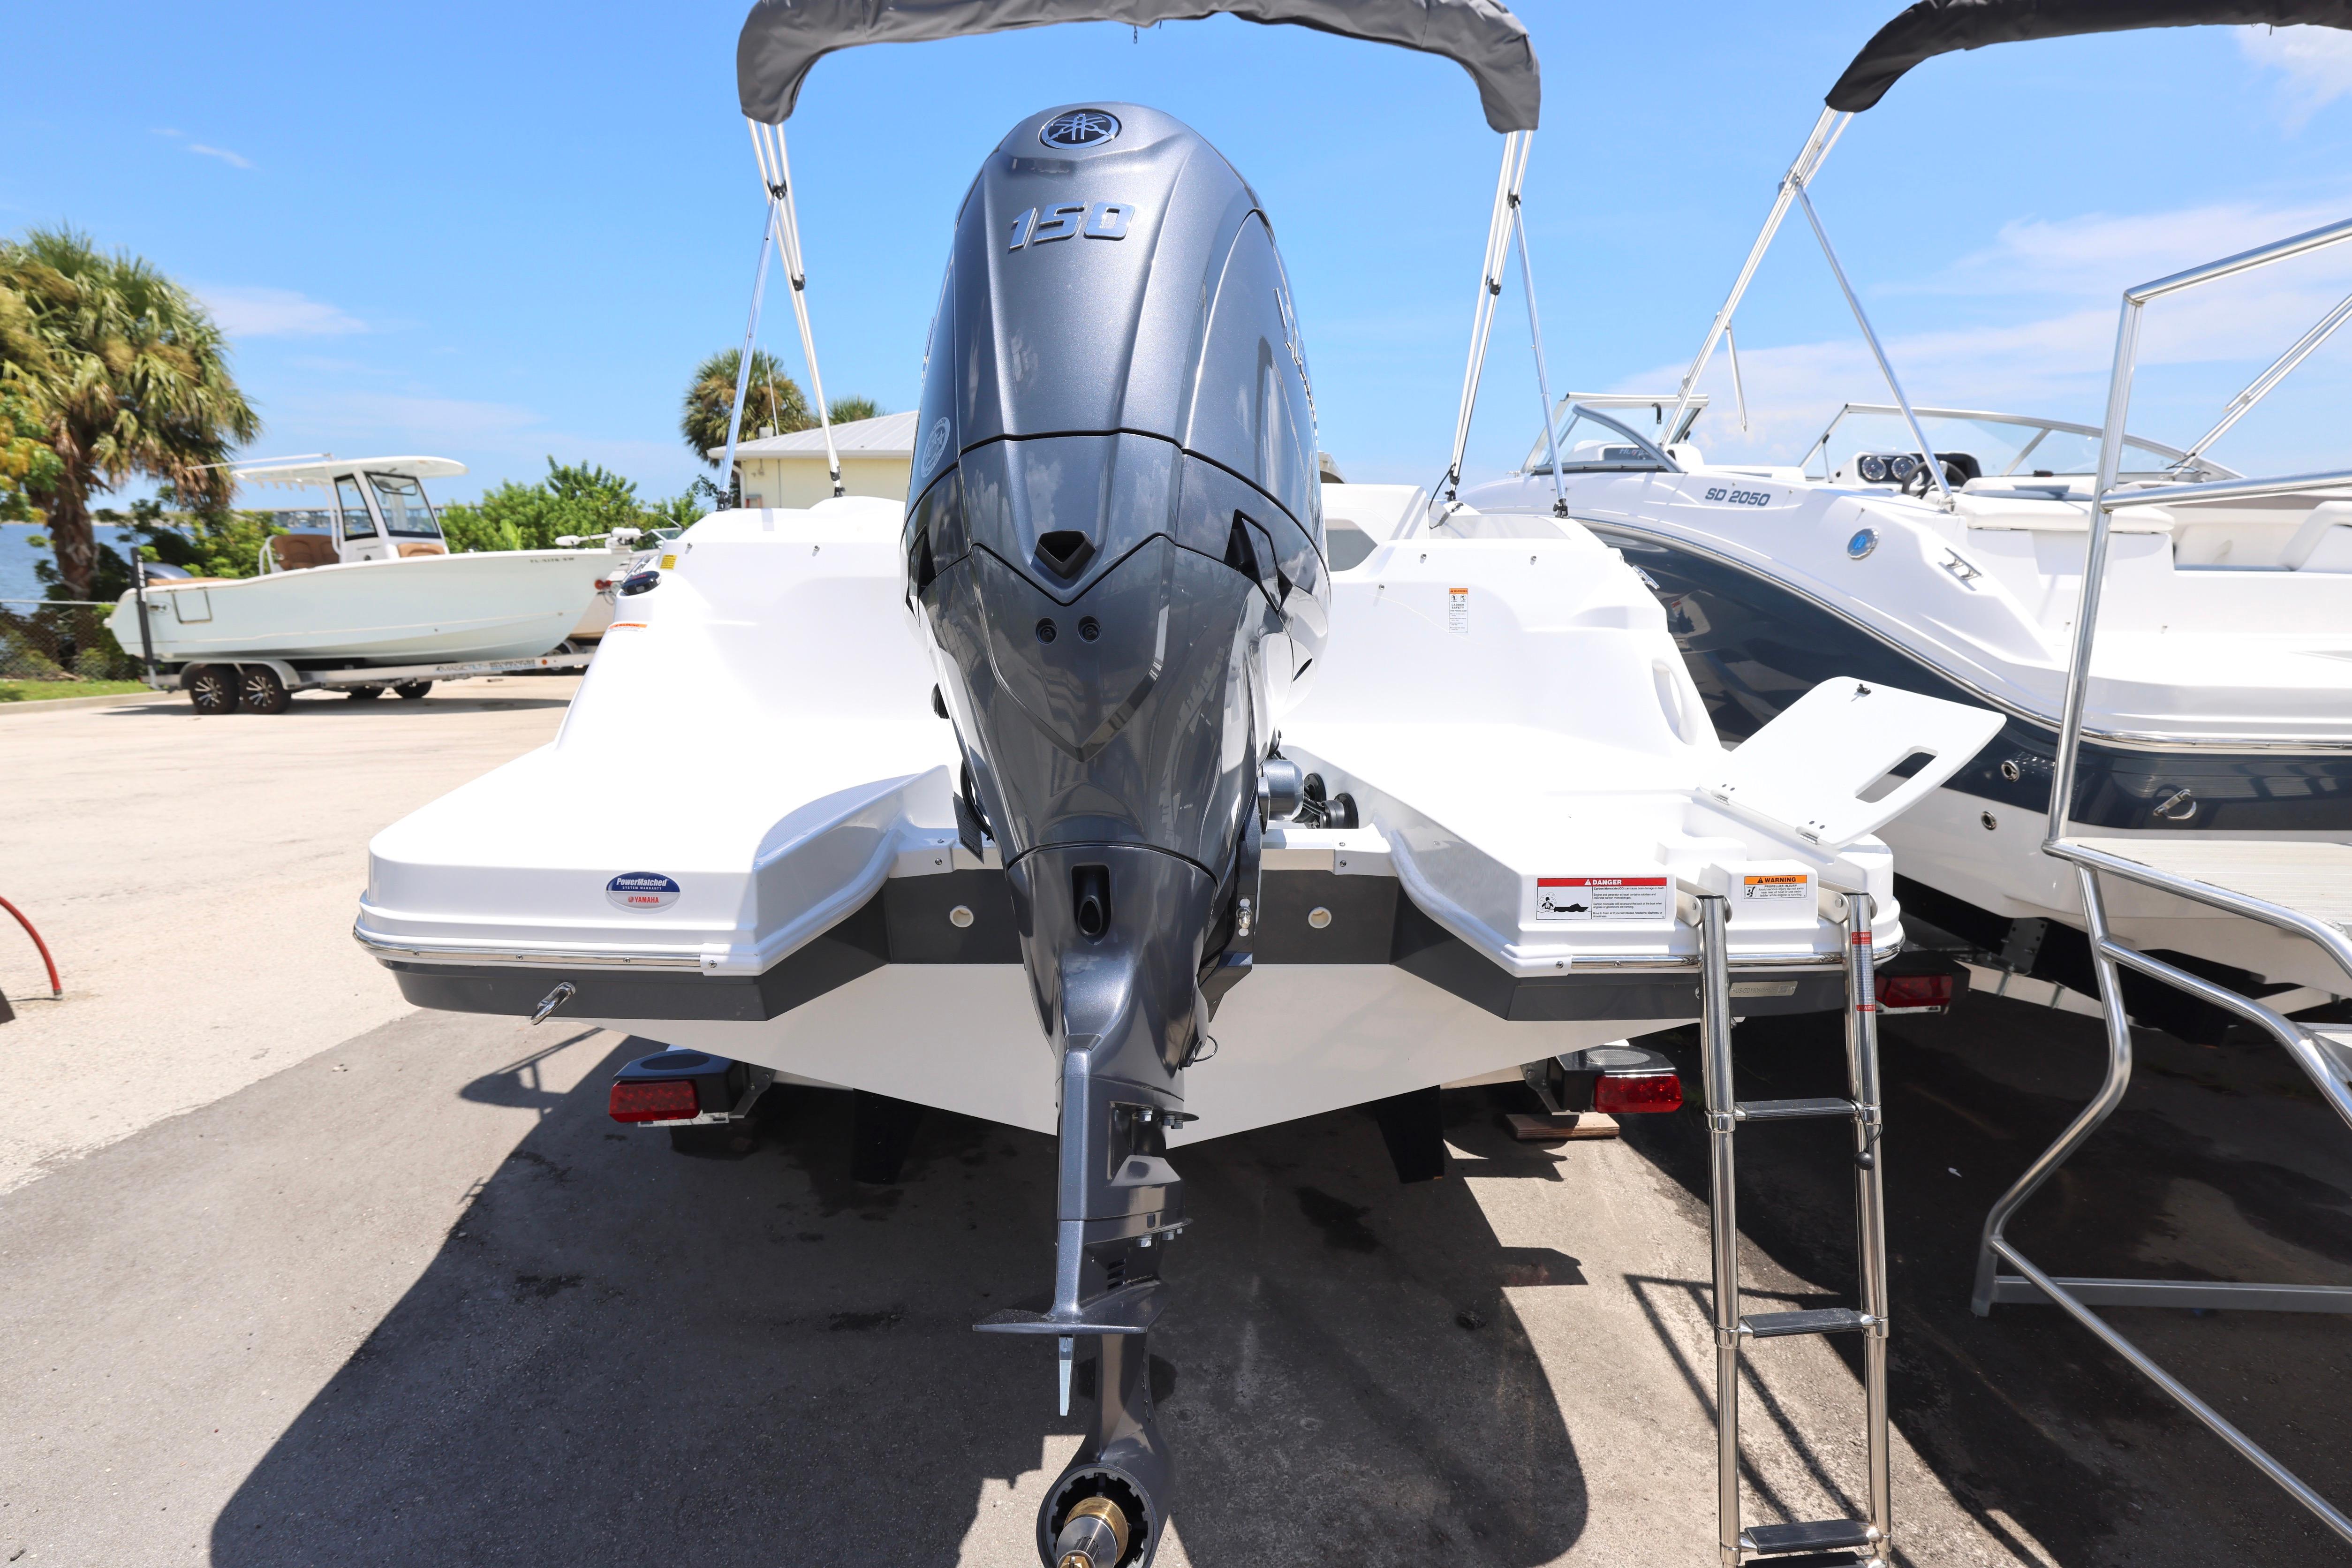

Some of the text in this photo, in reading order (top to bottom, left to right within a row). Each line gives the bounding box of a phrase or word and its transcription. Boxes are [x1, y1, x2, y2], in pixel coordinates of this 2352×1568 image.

[1009, 201, 1135, 250] 150
[1705, 488, 1771, 507] SD 2050
[616, 878, 667, 886] PowerMatched
